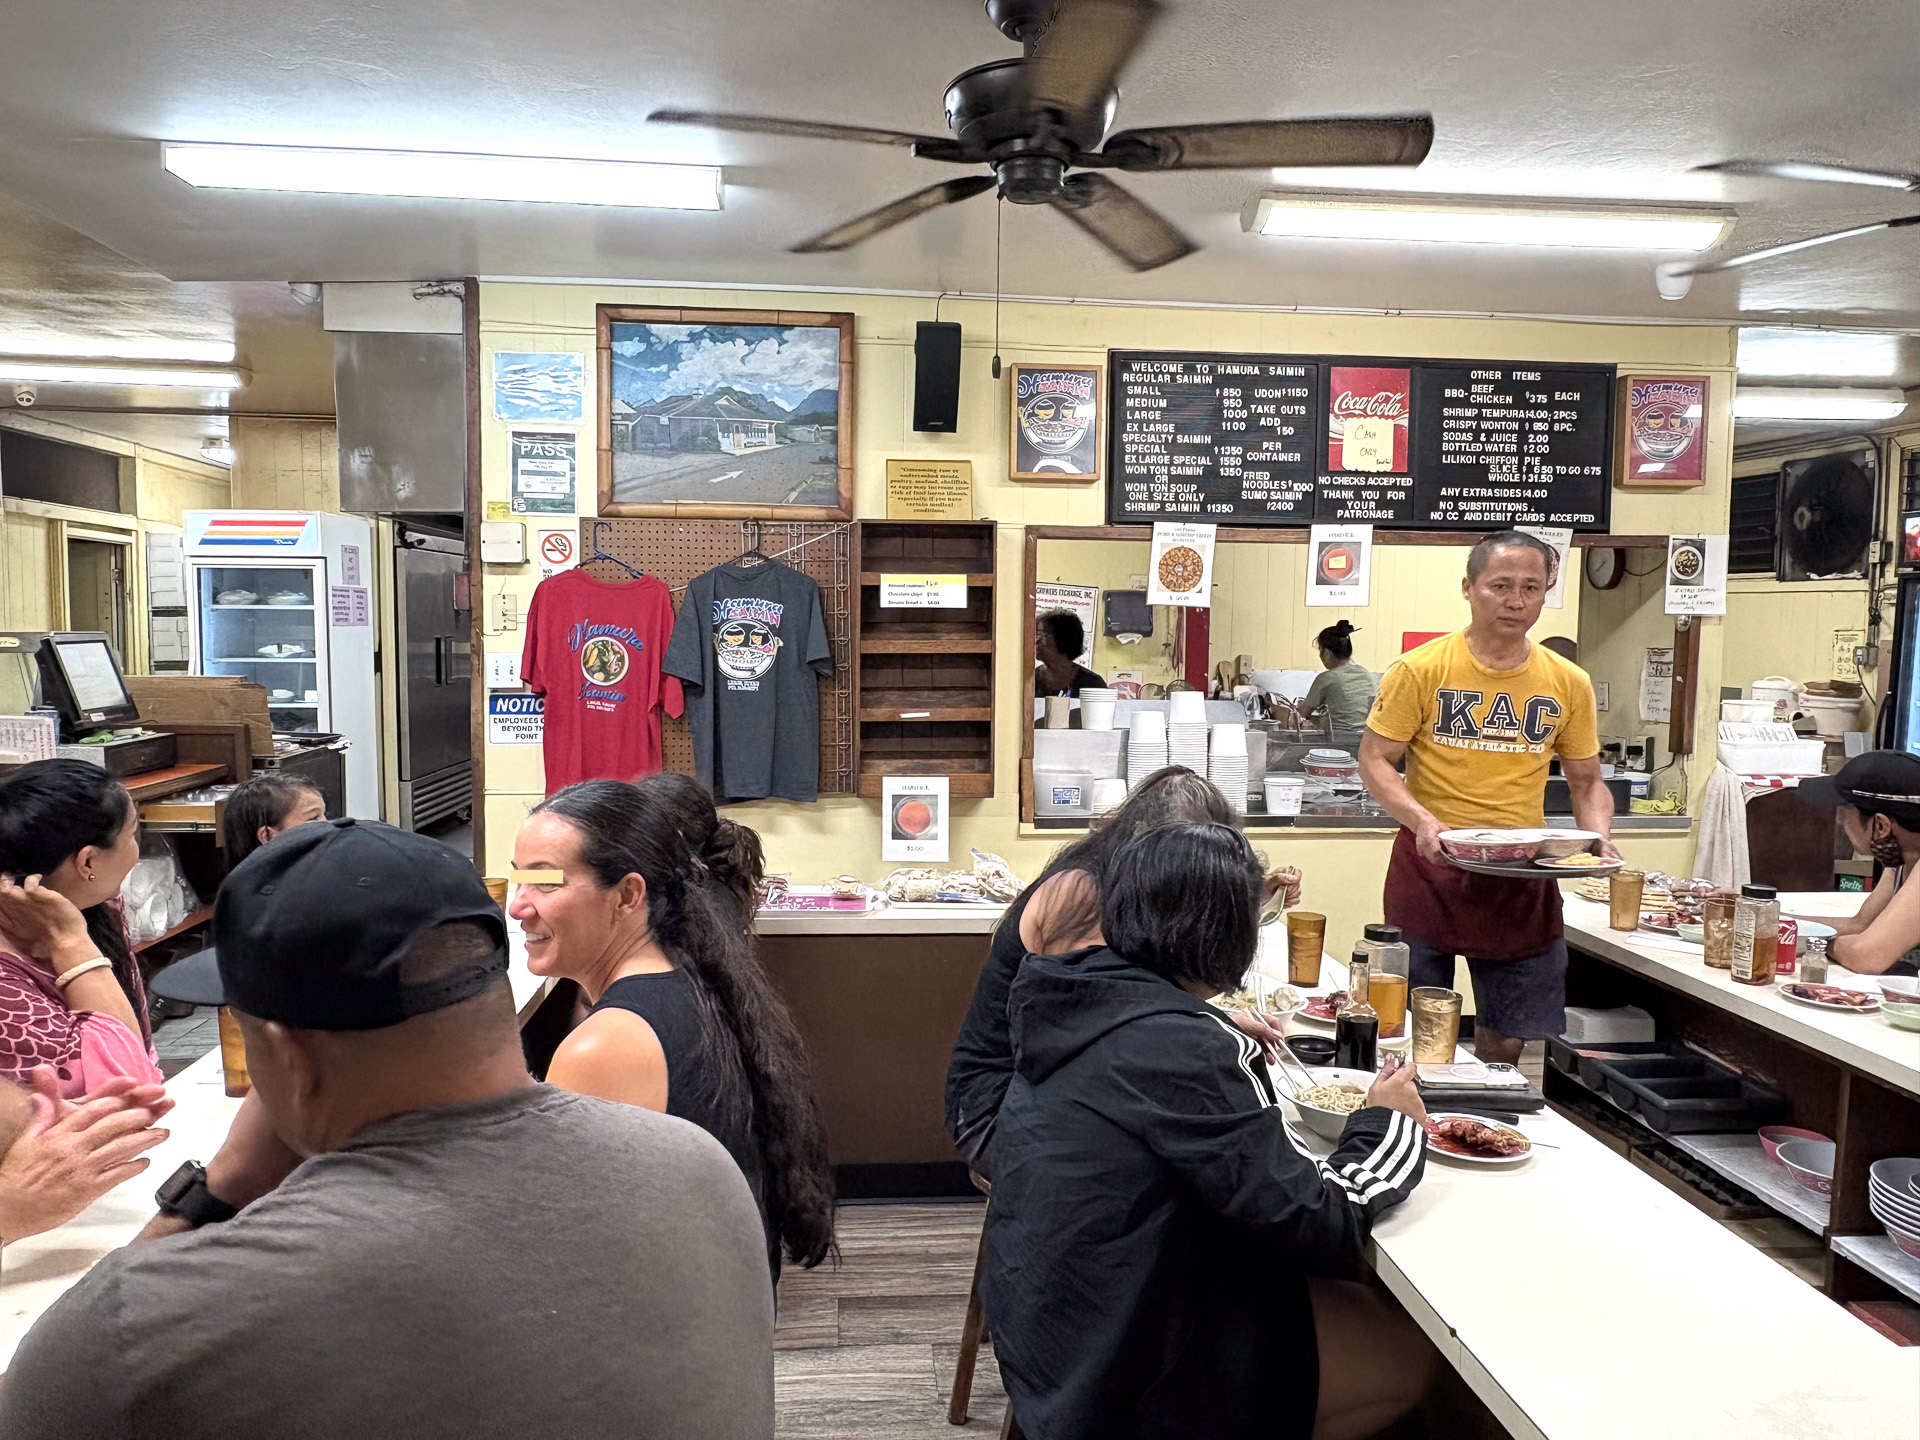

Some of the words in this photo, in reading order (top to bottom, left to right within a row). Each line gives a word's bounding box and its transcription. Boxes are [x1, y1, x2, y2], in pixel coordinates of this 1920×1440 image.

[1132, 363, 1183, 372] WELCOME
[1196, 365, 1209, 373] TO
[1218, 365, 1260, 374] HAMURA
[1269, 367, 1304, 376] SAIMIN
[1123, 373, 1171, 383] REGULAR
[1176, 375, 1212, 384] SAIMIN
[1471, 370, 1501, 379] OTHER
[1513, 372, 1541, 380] ITEMS
[1127, 386, 1161, 395] SMALL
[1471, 384, 1494, 393] BEEF
[1255, 389, 1280, 398] UDON
[1470, 395, 1512, 404] CHICKEN
[1555, 392, 1580, 400] EACH
[1126, 398, 1167, 407] MEDIUM
[1223, 399, 1242, 407] 950
[1250, 405, 1276, 413] TAKE
[1281, 406, 1306, 414] OUTS
[1443, 408, 1478, 417] SHRIMP
[1482, 409, 1524, 418] TEMPURA
[1127, 411, 1161, 419] LARGE
[1223, 410, 1248, 418] 1000
[1260, 417, 1280, 426] ADD
[1443, 420, 1477, 429] CRISPY
[1480, 421, 1519, 430] WONTON
[1127, 423, 1138, 431] EX
[1143, 423, 1175, 432] LARGE
[1222, 422, 1246, 430] 1100
[1277, 427, 1294, 435] 150
[1122, 434, 1173, 443] SPECIALTY
[1177, 435, 1211, 444] SAIMIN
[1443, 432, 1473, 441] SODAS
[1480, 433, 1486, 441] &
[1490, 434, 1517, 442] JUICE
[521, 443, 566, 457] PASS
[1125, 444, 1167, 453] SPECIAL
[1262, 442, 1281, 451] PER
[1443, 443, 1482, 451] BOTTLED
[1485, 444, 1517, 452] WATER
[1125, 455, 1136, 463] EX
[1139, 455, 1170, 464] LARGE
[1173, 456, 1212, 465] SPECIAL
[1220, 457, 1242, 465] 1550
[1247, 452, 1300, 461] CONTAINER
[1443, 455, 1476, 464] LILIKOI
[1480, 456, 1518, 464] CHIFFON
[1525, 457, 1541, 465] PIE
[1125, 465, 1147, 474] WON
[1149, 466, 1167, 474] TON
[1170, 466, 1204, 475] SAIMIN
[1220, 468, 1242, 476] 1350
[1490, 465, 1518, 473] SLICE
[1556, 466, 1566, 474] TO
[1569, 466, 1580, 474] GO
[1155, 475, 1168, 483] OR
[1244, 472, 1270, 480] FRIED
[1488, 473, 1520, 482] WHOLE
[1243, 480, 1287, 489] NOODLES
[1333, 476, 1365, 485] CHECKS
[1367, 477, 1413, 486] ACCEPTED
[1125, 483, 1147, 491] WON
[1149, 484, 1167, 492] TON
[1170, 484, 1197, 492] SOUP
[1129, 492, 1148, 500] ONE
[1153, 492, 1175, 501] SIZE
[1179, 493, 1205, 502] ONLY
[1241, 491, 1267, 499] SUMO
[1270, 492, 1302, 500] SAIMIN
[1323, 490, 1354, 499] THANK
[1362, 491, 1379, 499] YOU
[1387, 491, 1405, 500] FOR
[1441, 488, 1460, 496] ANY
[1463, 488, 1493, 497] EXTRA
[1494, 489, 1521, 497] SIDES
[1125, 502, 1160, 511] SHRIMP
[1165, 503, 1200, 512] SAIMIN
[1347, 501, 1376, 509] YOUR
[1440, 501, 1453, 510] NO
[1337, 510, 1394, 518] PATRONAGE
[1431, 512, 1443, 520] NO
[1446, 512, 1459, 520] CC
[1464, 512, 1482, 520] AND
[1484, 513, 1512, 521] DEBIT
[1515, 513, 1545, 522] CARDS
[1550, 513, 1594, 522] ACCEPTED
[496, 698, 545, 712] NOTIC
[1433, 689, 1561, 744] KAC
[1840, 877, 1862, 891] Sprite
